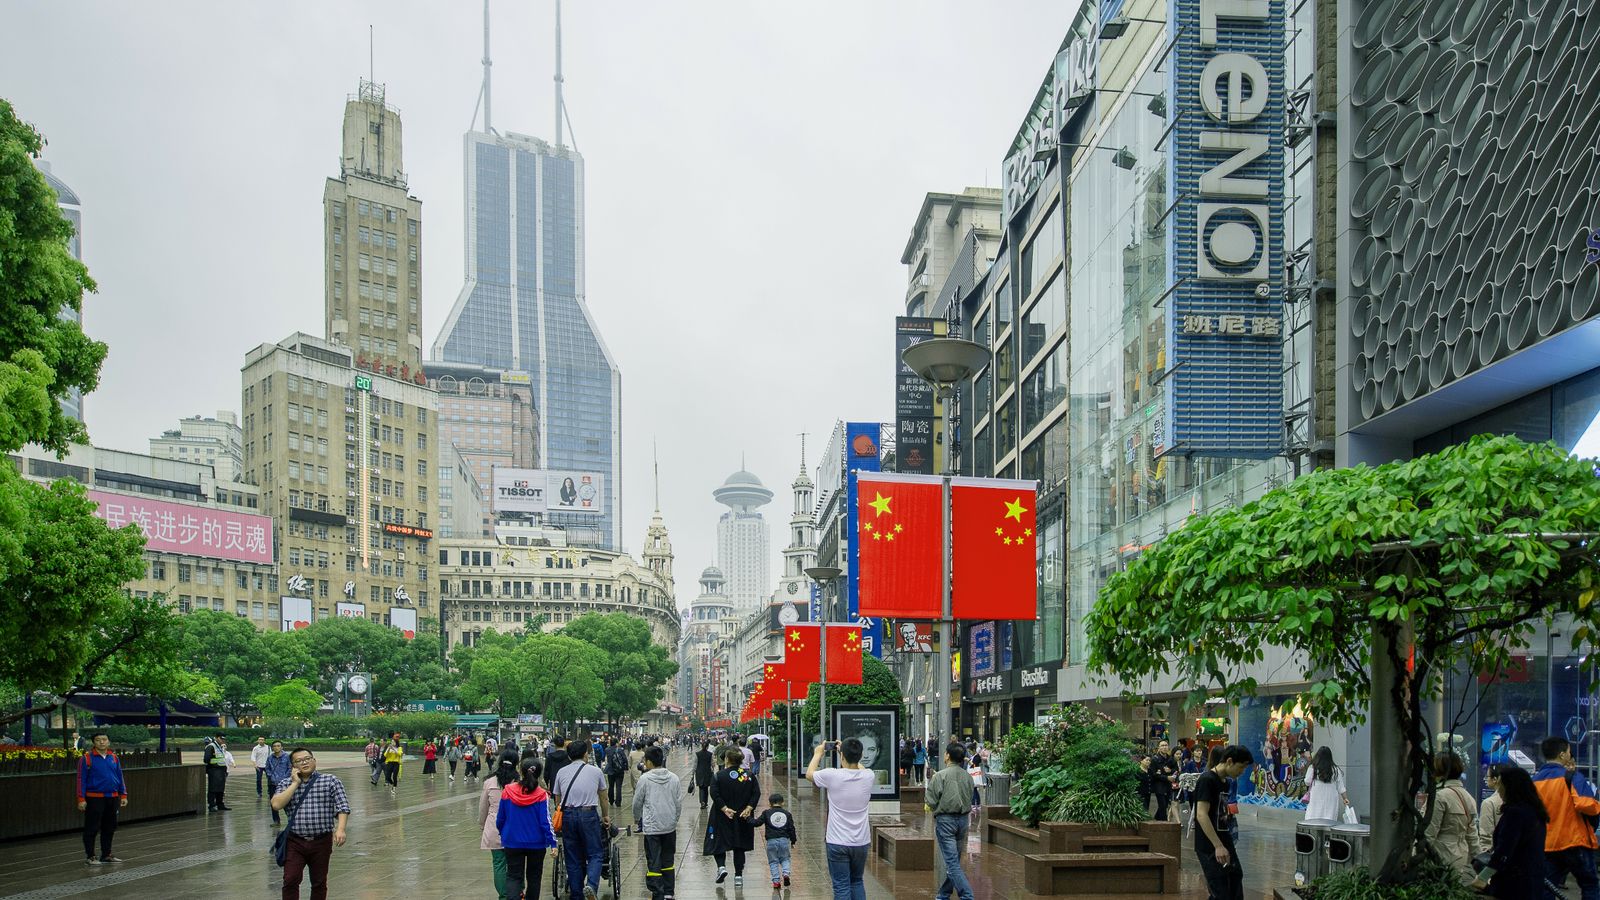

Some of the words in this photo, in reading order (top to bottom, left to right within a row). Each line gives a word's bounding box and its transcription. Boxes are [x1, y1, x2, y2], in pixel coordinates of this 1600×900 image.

[1183, 313, 1280, 336] 班尼路
[901, 420, 929, 434] 陶瓷
[499, 487, 543, 497] TISSOT
[94, 503, 267, 555] 民族进步的灵魂
[1021, 667, 1049, 687] Bershka
